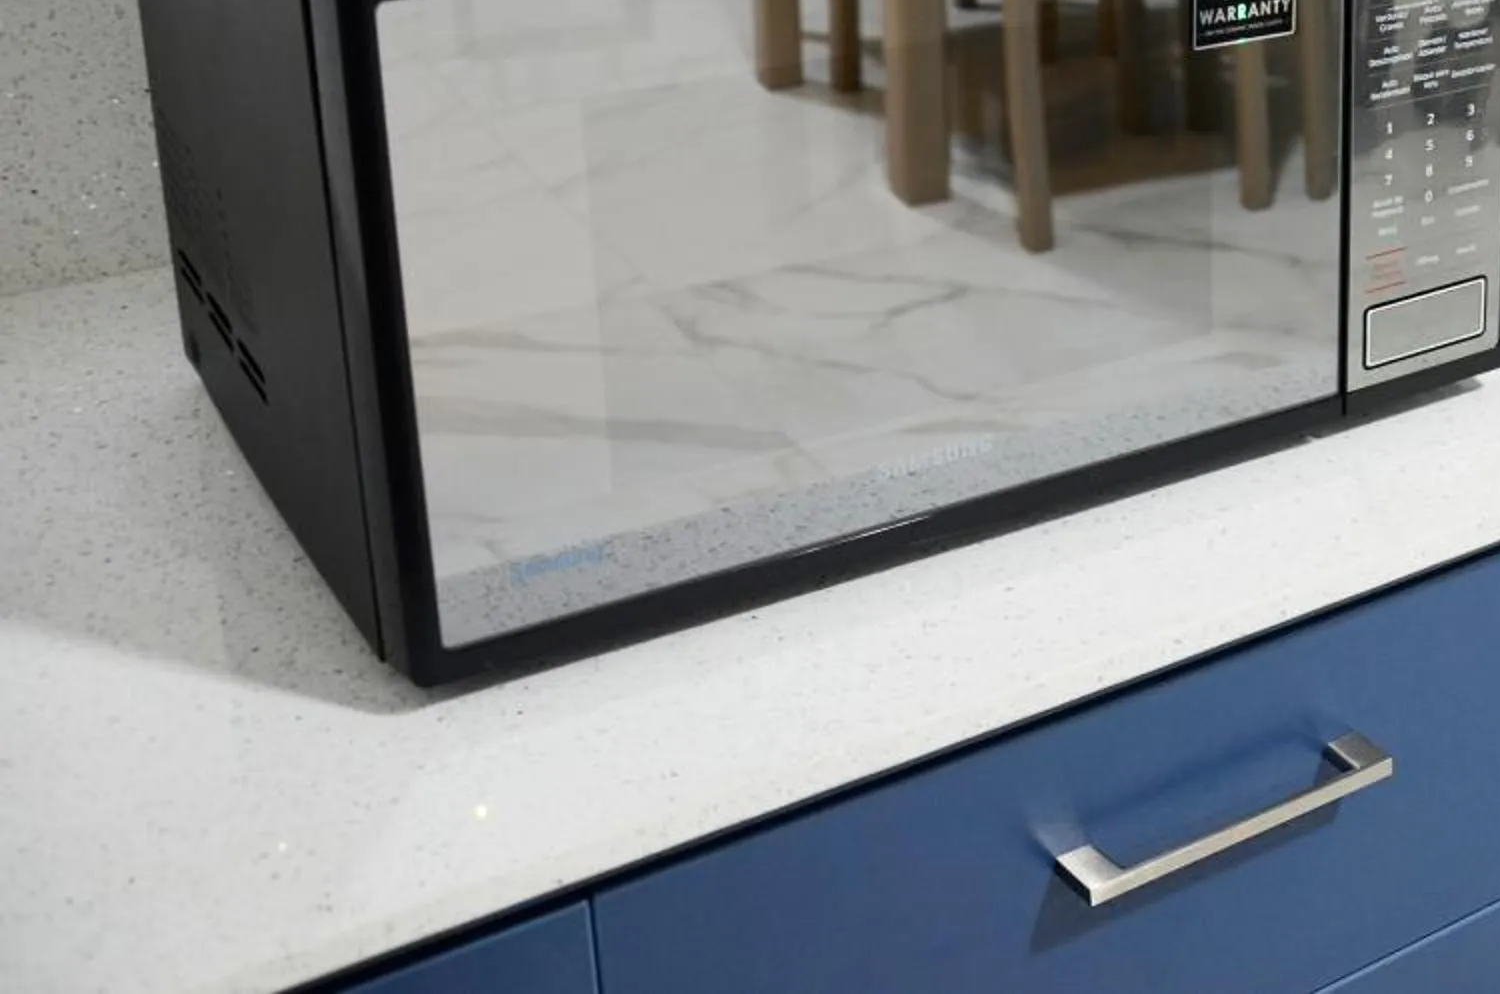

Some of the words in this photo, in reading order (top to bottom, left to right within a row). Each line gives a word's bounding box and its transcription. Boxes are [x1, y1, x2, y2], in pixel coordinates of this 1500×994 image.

[1386, 122, 1393, 134] 1
[1427, 113, 1435, 126] 2
[1467, 103, 1476, 116] 3
[1385, 148, 1393, 160] 4
[1425, 138, 1434, 151] 5
[1466, 129, 1475, 141] 6
[1384, 173, 1393, 186] 7
[1425, 164, 1433, 178] 8
[1465, 156, 1473, 168] 9
[1424, 190, 1433, 203] 0
